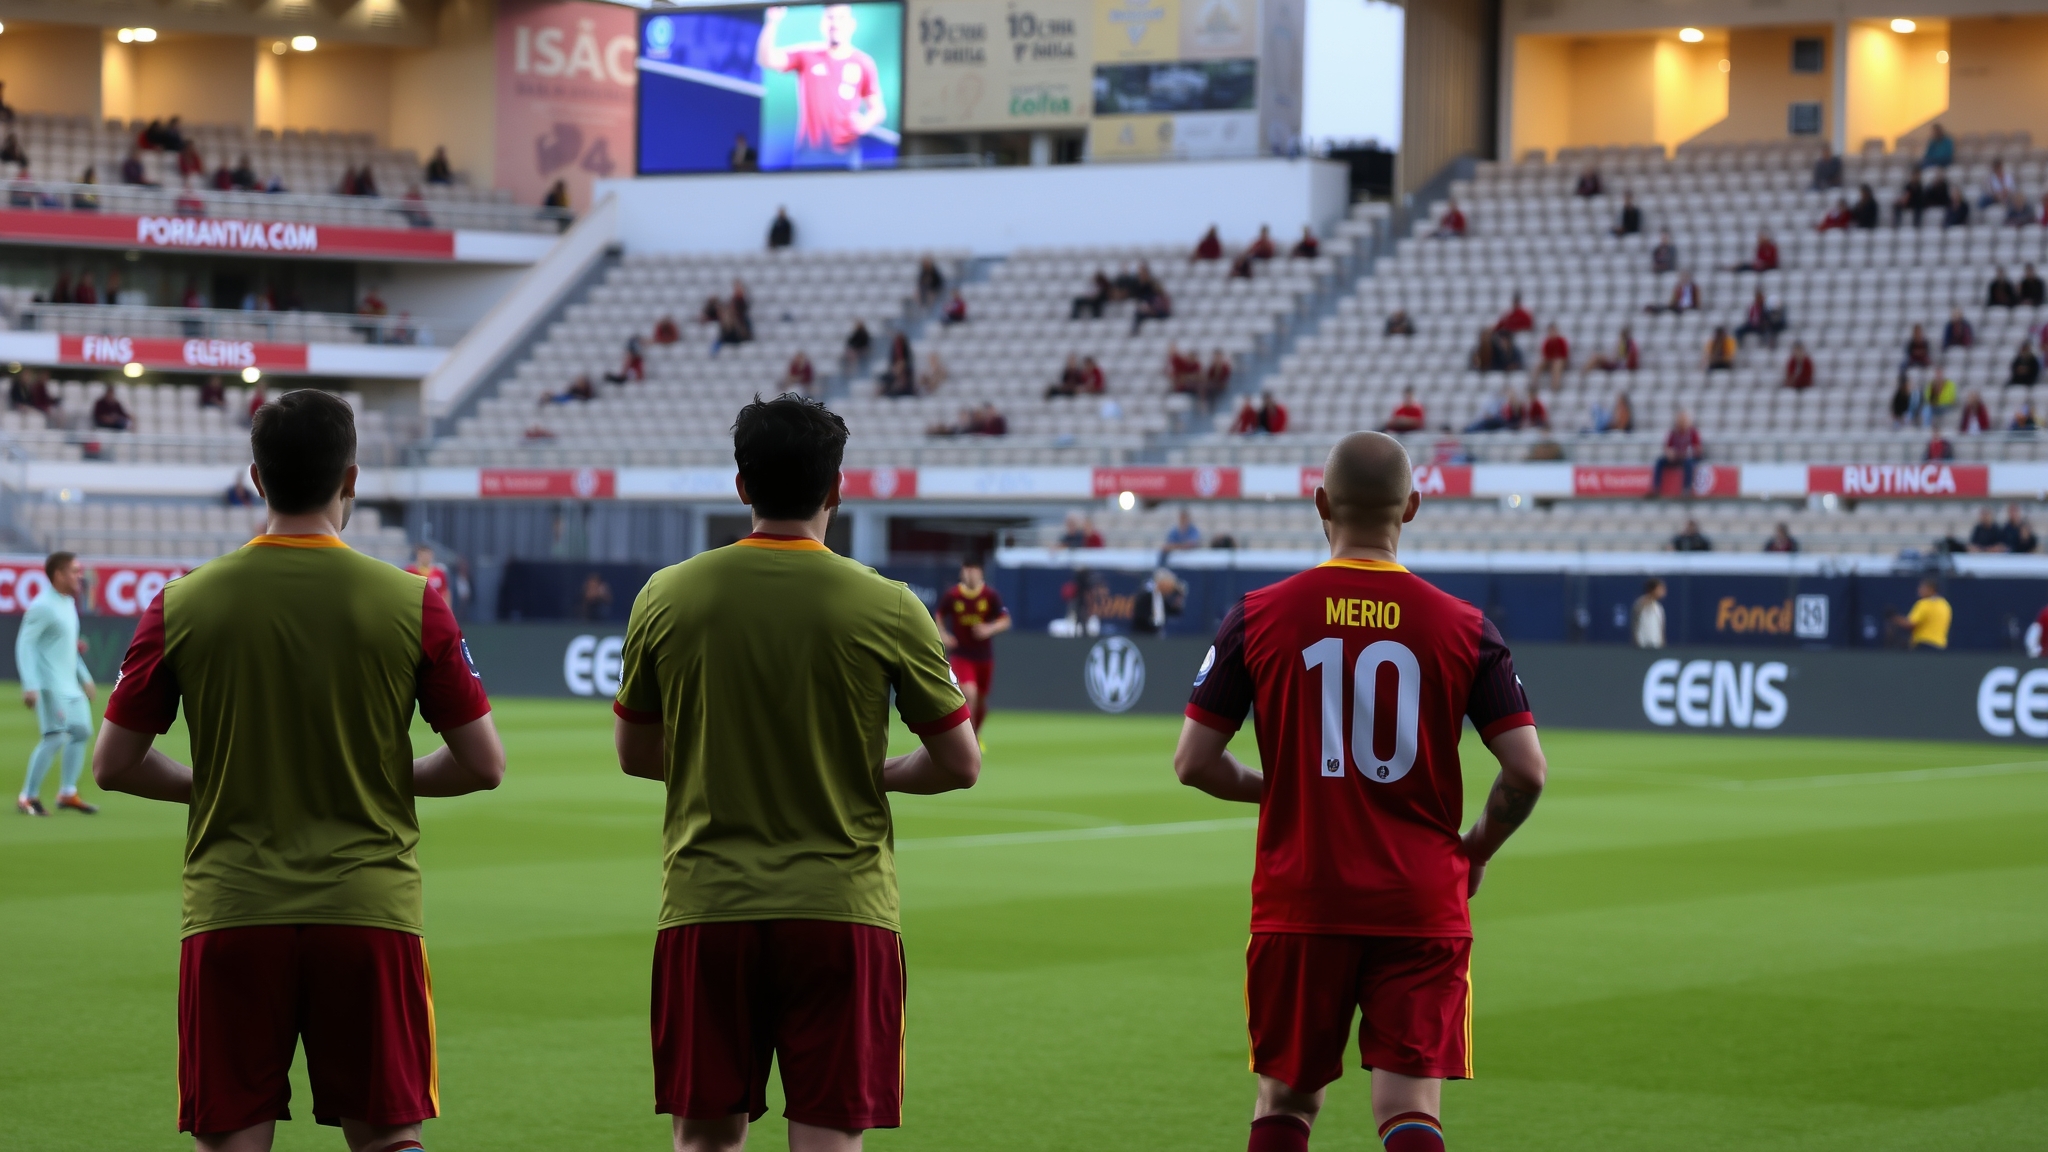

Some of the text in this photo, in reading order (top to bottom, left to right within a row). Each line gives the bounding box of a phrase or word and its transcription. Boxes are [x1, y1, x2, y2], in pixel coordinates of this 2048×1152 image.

[1842, 466, 1956, 495] RUTINCA
[1326, 597, 1401, 630] MERIO
[1302, 637, 1421, 784] 10
[1641, 658, 1789, 730] EENS
